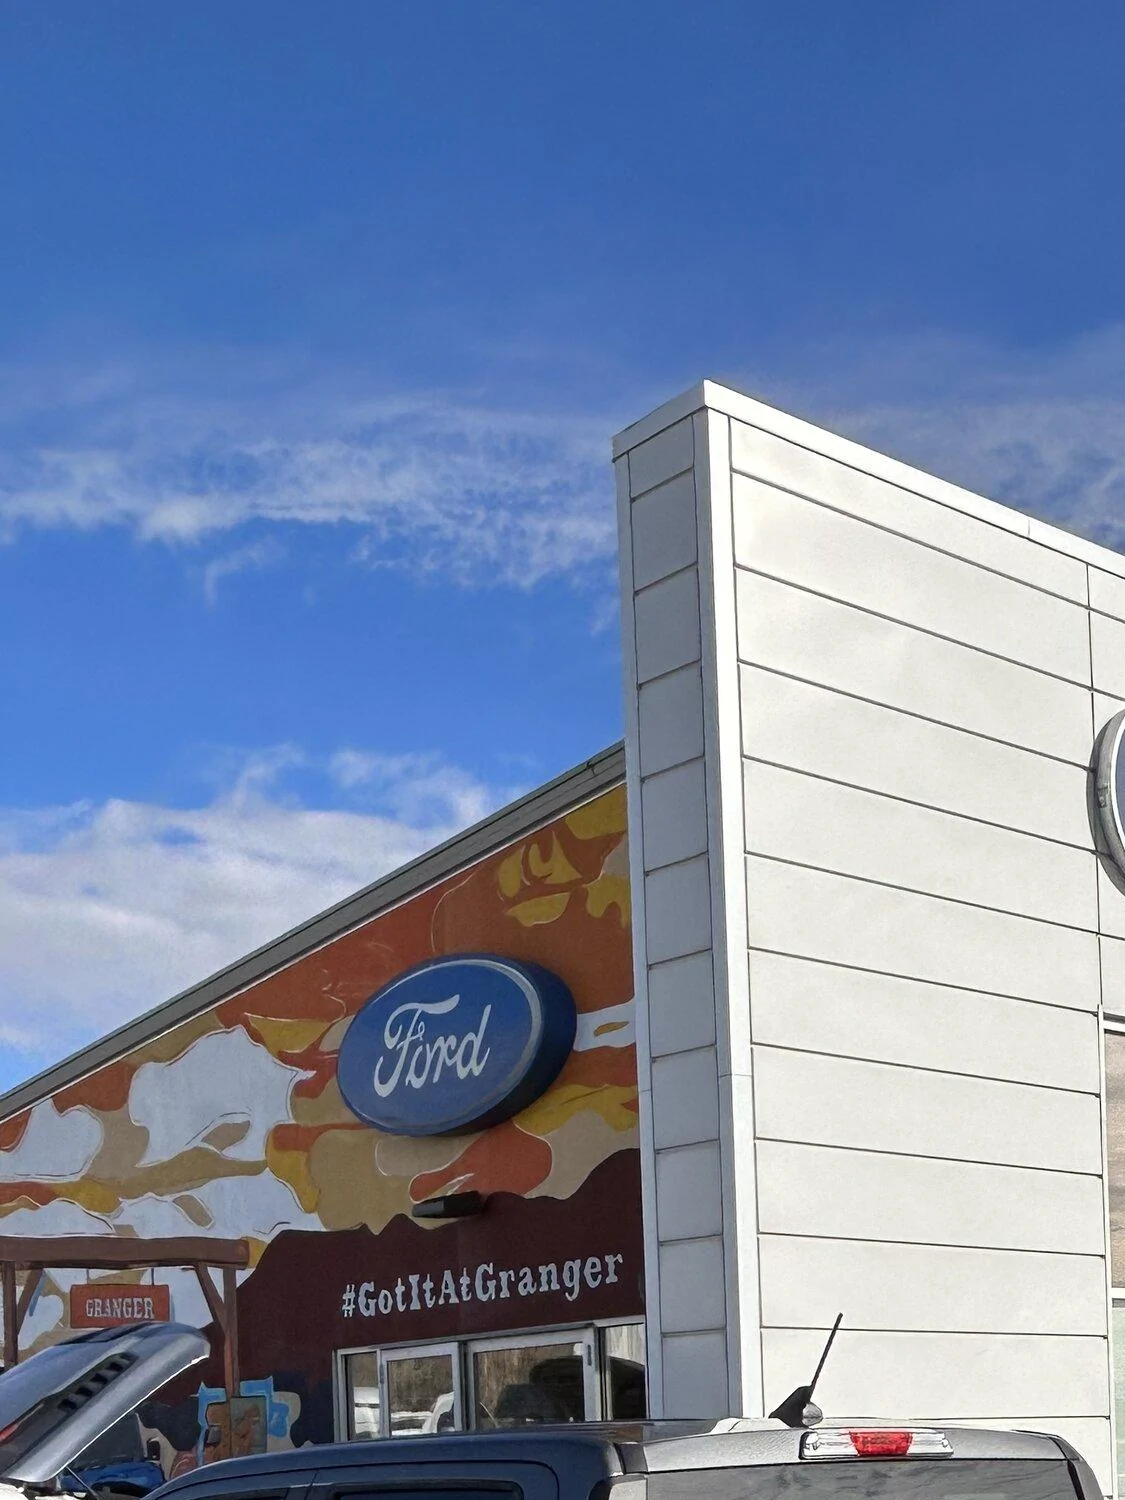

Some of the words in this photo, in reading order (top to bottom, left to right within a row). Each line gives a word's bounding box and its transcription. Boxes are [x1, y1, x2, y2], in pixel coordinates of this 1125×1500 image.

[374, 994, 491, 1097] Ford
[86, 1297, 155, 1319] GRANGER
[342, 1253, 624, 1318] #GotItAtGranger
